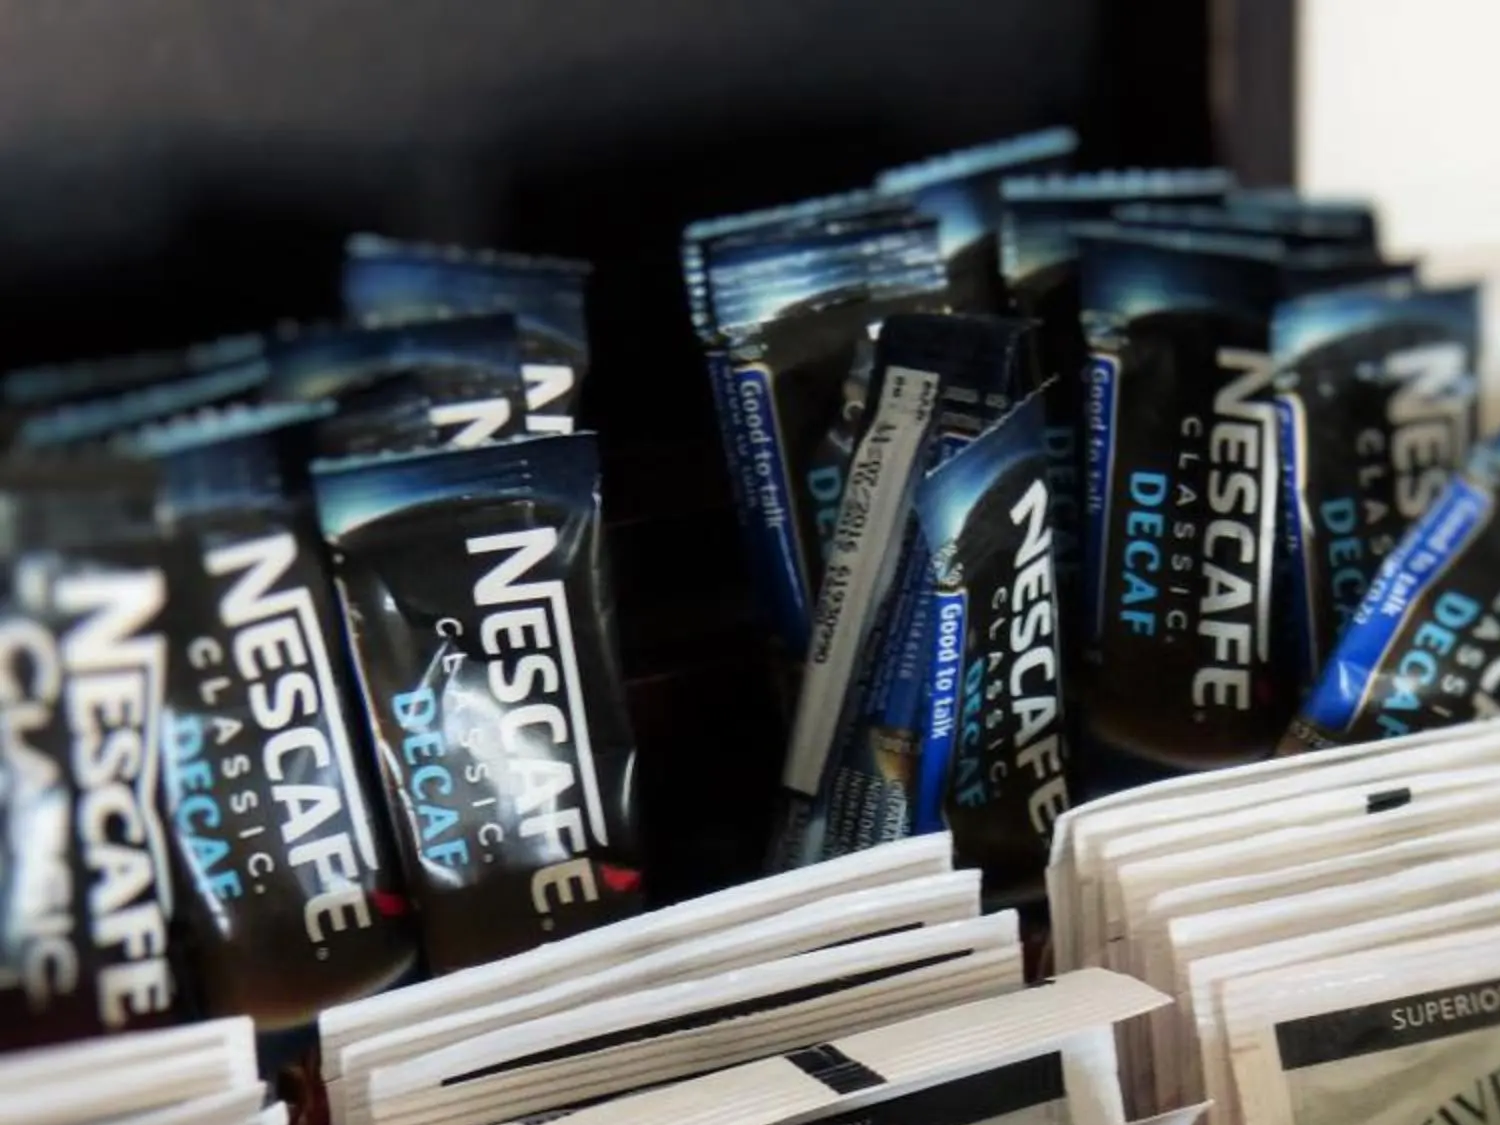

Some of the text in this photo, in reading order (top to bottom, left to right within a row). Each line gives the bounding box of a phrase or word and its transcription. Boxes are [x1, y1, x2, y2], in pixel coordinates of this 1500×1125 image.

[738, 378, 785, 527] Good to talk
[1087, 366, 1111, 433] Good
[1119, 470, 1169, 638] DECAF
[930, 602, 962, 739] Good to talk
[957, 656, 987, 808] DECAF
[168, 710, 244, 902] DECAF
[391, 685, 469, 872] DECAF
